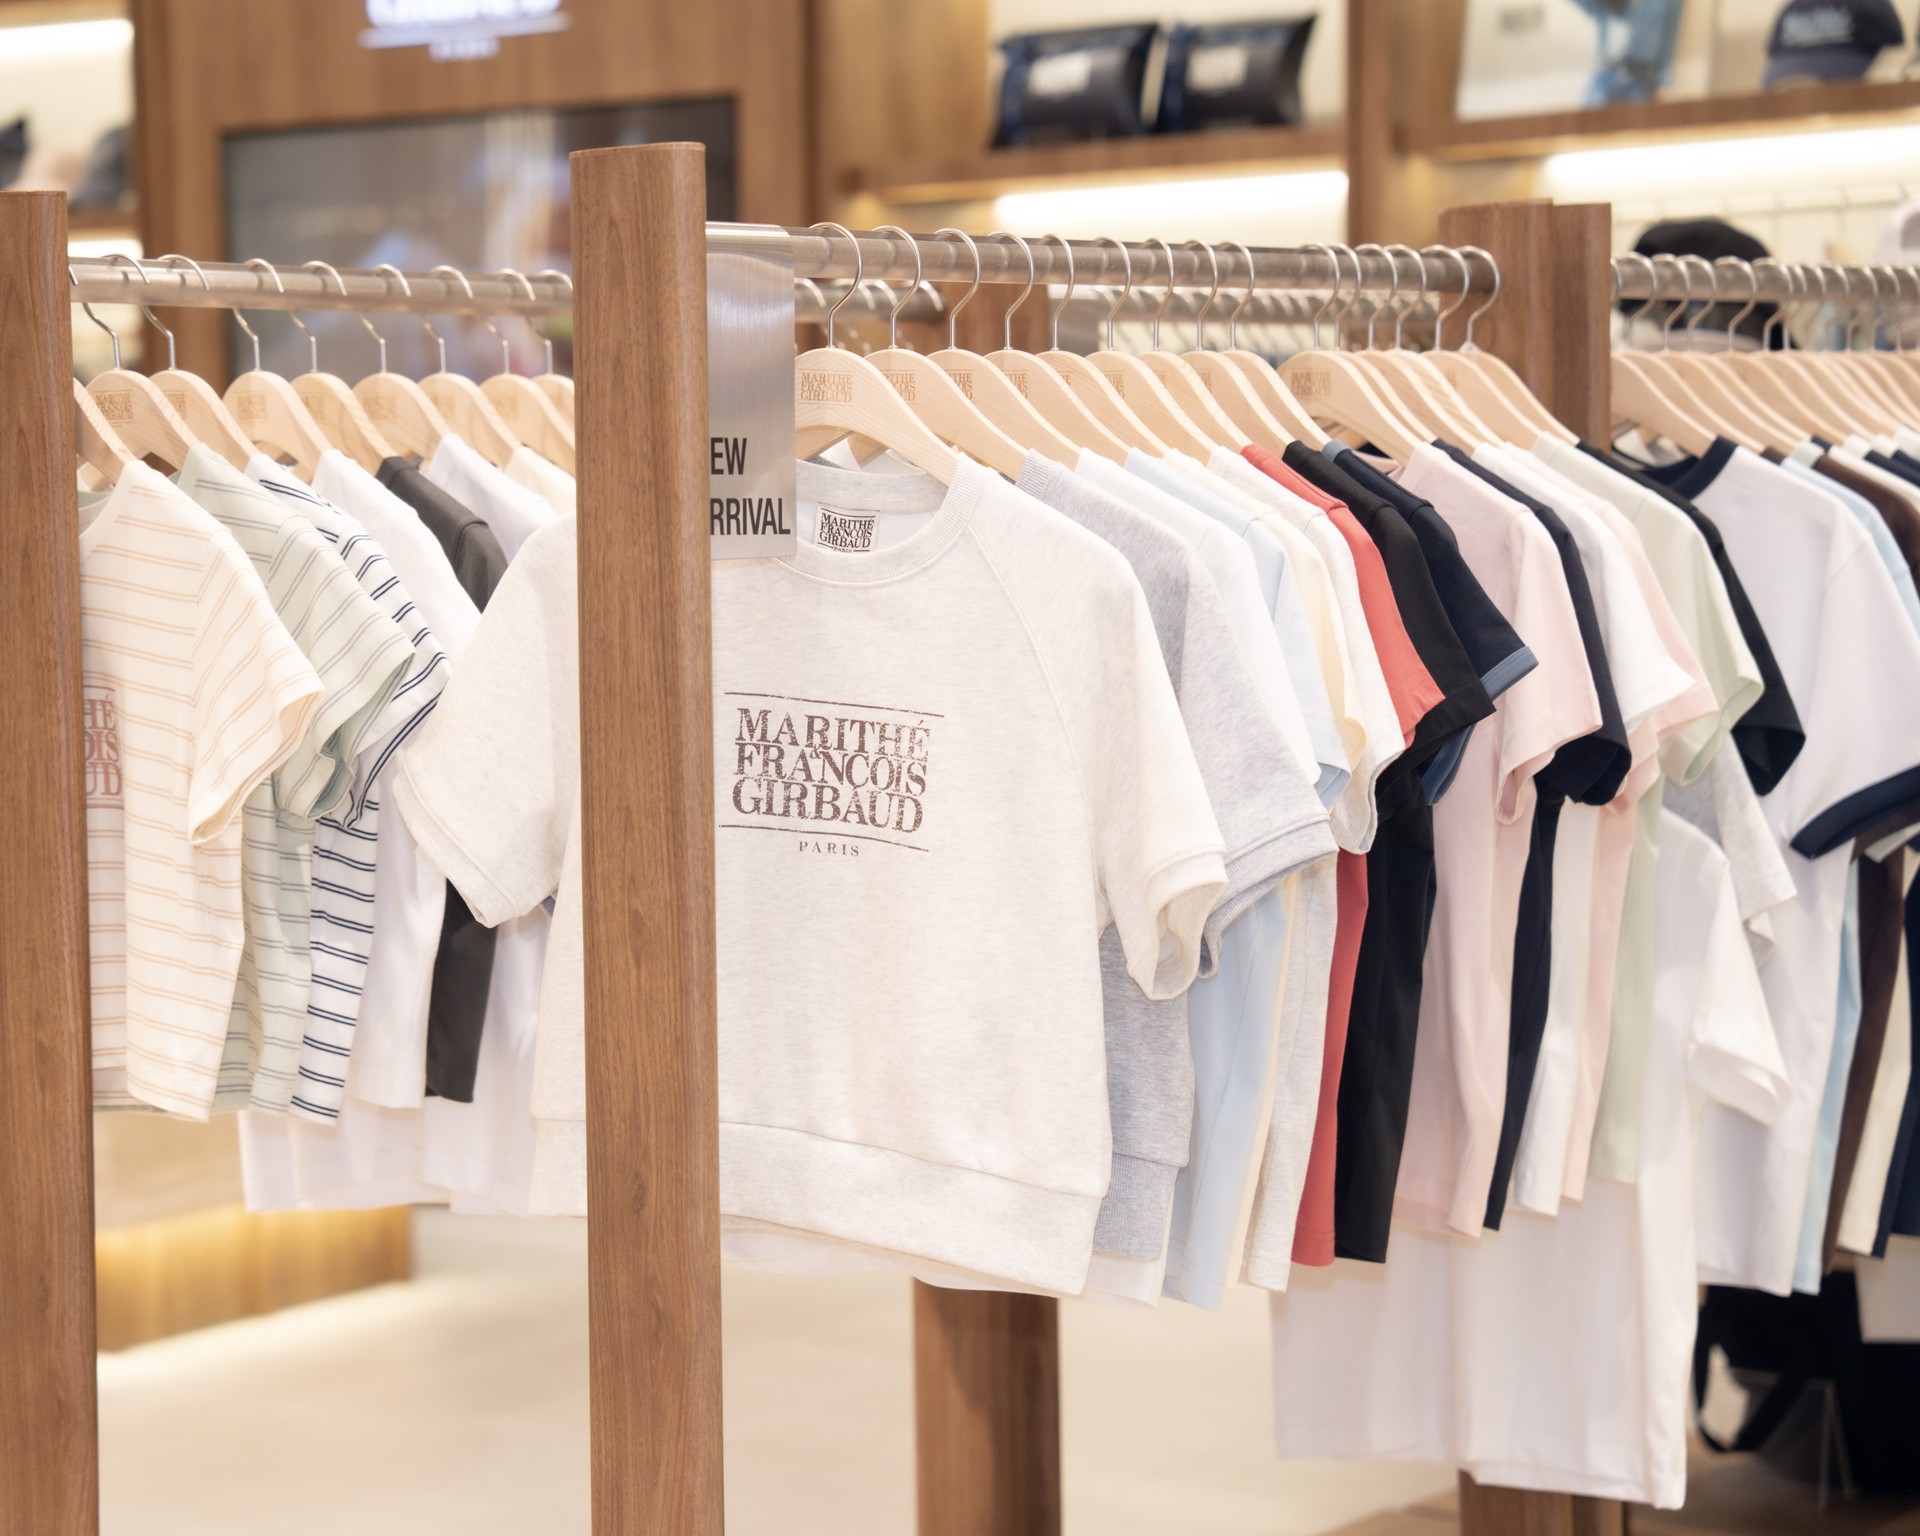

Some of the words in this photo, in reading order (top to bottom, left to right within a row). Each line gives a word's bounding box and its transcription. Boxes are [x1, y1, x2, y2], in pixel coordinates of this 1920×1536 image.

[710, 437, 748, 476] EW
[710, 498, 791, 536] RRIVAL
[819, 531, 871, 548] GIRBAUD
[735, 707, 931, 763] MARITHÉ
[732, 776, 924, 834] GIRBAUD
[799, 840, 860, 857] PARIS
